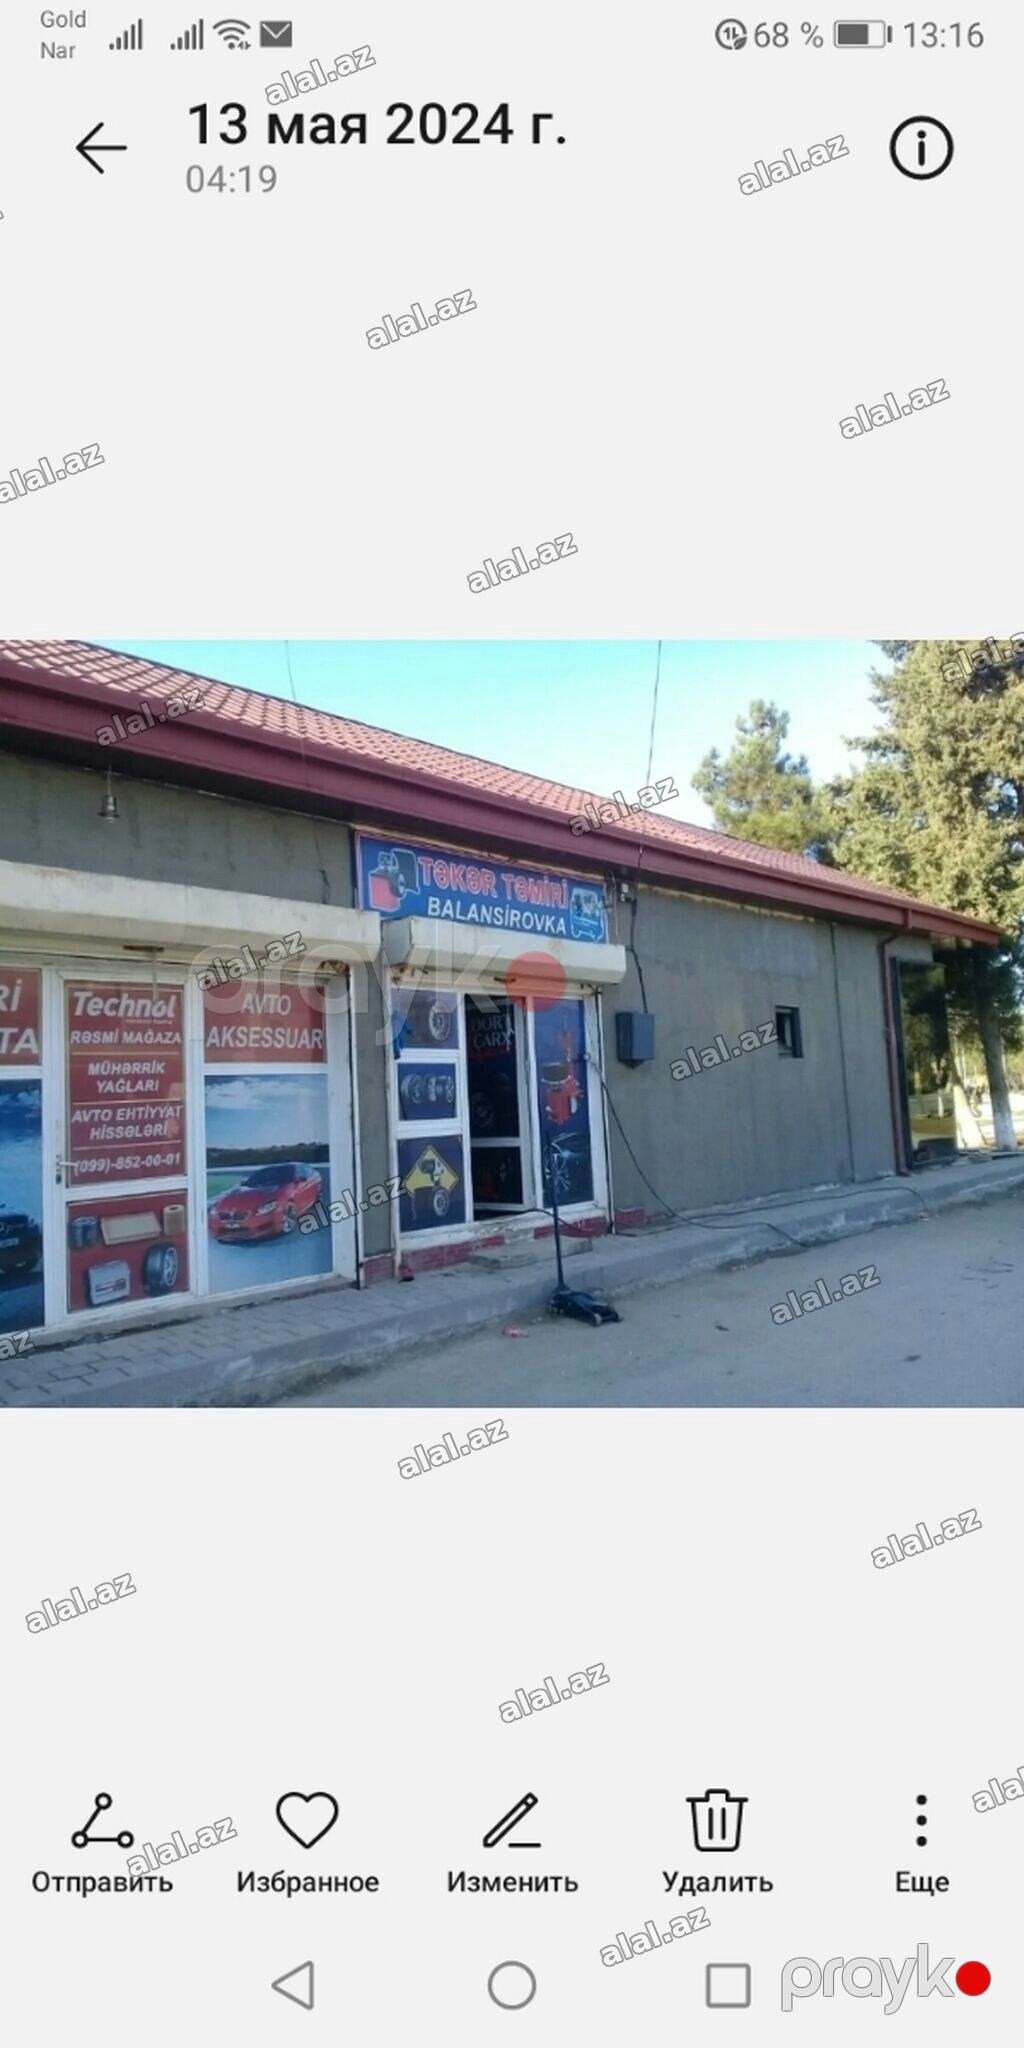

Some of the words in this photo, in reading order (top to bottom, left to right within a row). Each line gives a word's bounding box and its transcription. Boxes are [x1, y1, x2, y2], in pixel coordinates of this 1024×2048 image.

[39, 9, 86, 29] Gold
[754, 22, 790, 49] 68
[800, 21, 824, 48] %
[903, 21, 985, 49] 13:16
[40, 41, 76, 60] Nar
[188, 101, 248, 146] 13
[266, 110, 368, 146] мая
[385, 101, 515, 146] 2024
[531, 112, 566, 146] г.
[185, 165, 277, 194] 04:19
[418, 856, 499, 899] TƏKƏR
[501, 873, 570, 911] TƏMİRİ
[427, 895, 567, 936] BALANSİROVKA
[73, 991, 177, 1019] Technol
[240, 993, 293, 1016] AVTO
[70, 1028, 119, 1044] RƏSMİ
[122, 1027, 183, 1044] MAĞAZA
[205, 1026, 323, 1049] AKSESSUAR
[88, 1059, 167, 1076] MÜHƏRRİK
[96, 1078, 160, 1094] YAĞLARI
[71, 1108, 113, 1124] AVTO
[116, 1104, 185, 1122] EHTİYYAT
[89, 1121, 169, 1141] HİSSƏLƏRİ
[74, 1152, 181, 1177] (099)-852-00-01
[31, 1870, 174, 1899] Отправить
[237, 1869, 380, 1899] Избранное
[447, 1870, 579, 1893] Изменить
[661, 1870, 774, 1898] Удалить
[895, 1870, 950, 1898] Еще
